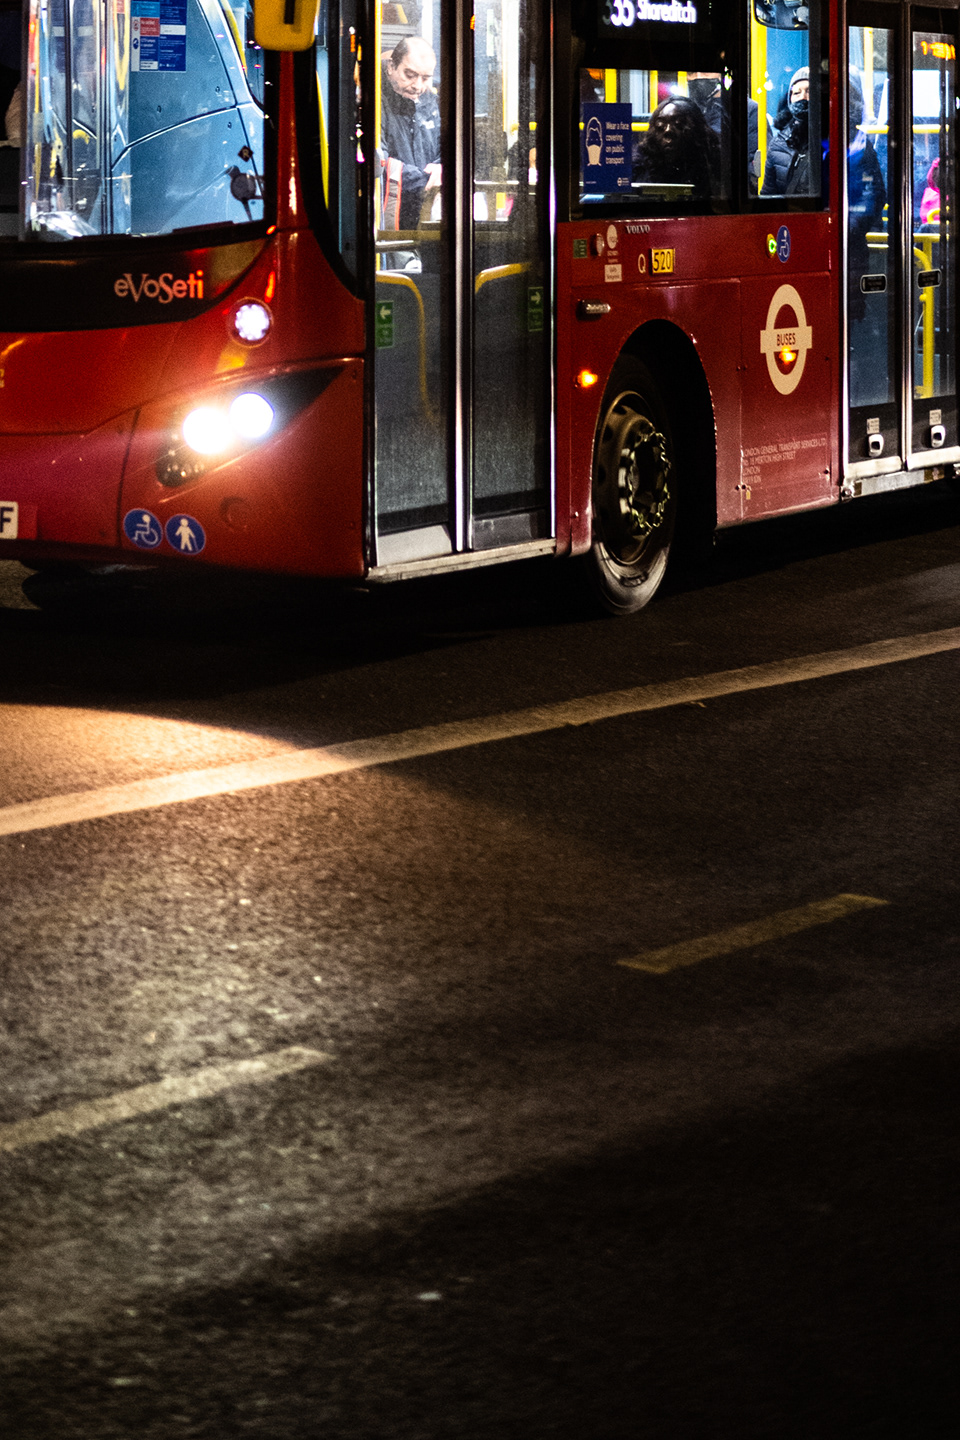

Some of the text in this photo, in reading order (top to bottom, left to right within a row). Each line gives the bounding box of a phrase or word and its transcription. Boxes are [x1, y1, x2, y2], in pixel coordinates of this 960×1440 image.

[626, 225, 651, 235] VOLVO
[638, 253, 646, 273] Q
[653, 251, 672, 271] 520
[114, 269, 204, 304] eVoSeti
[777, 333, 796, 346] BUSES
